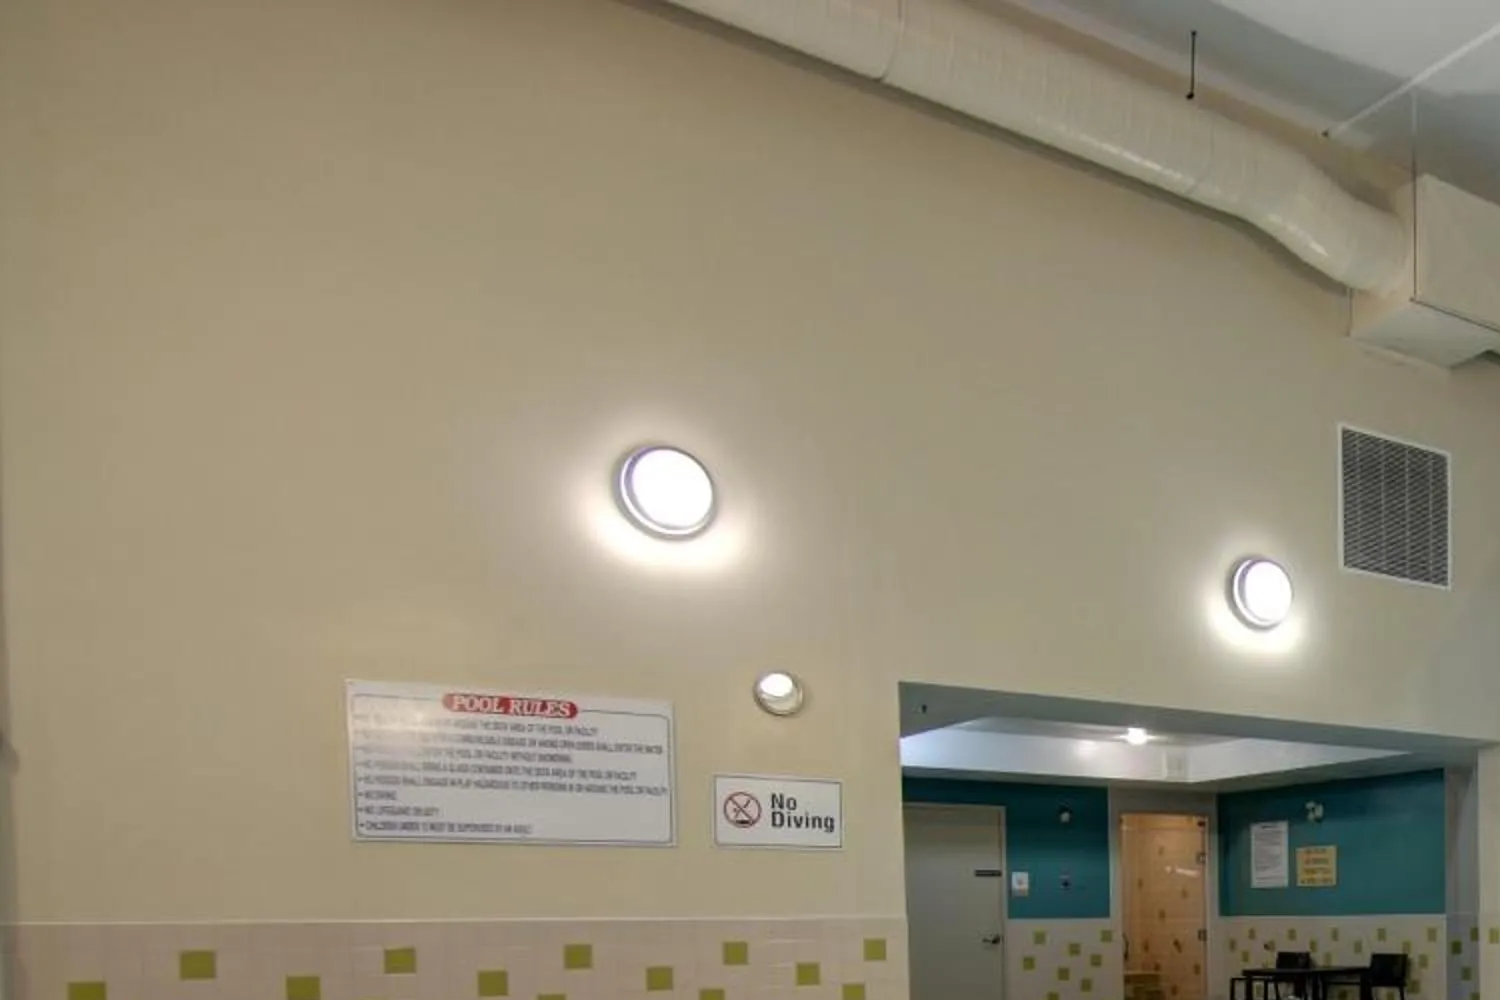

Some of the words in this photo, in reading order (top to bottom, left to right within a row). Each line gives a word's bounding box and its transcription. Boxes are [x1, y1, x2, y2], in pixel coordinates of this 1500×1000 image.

[454, 696, 504, 713] POOL
[510, 700, 571, 716] RULES
[770, 793, 797, 811] No
[771, 811, 835, 833] Diving
